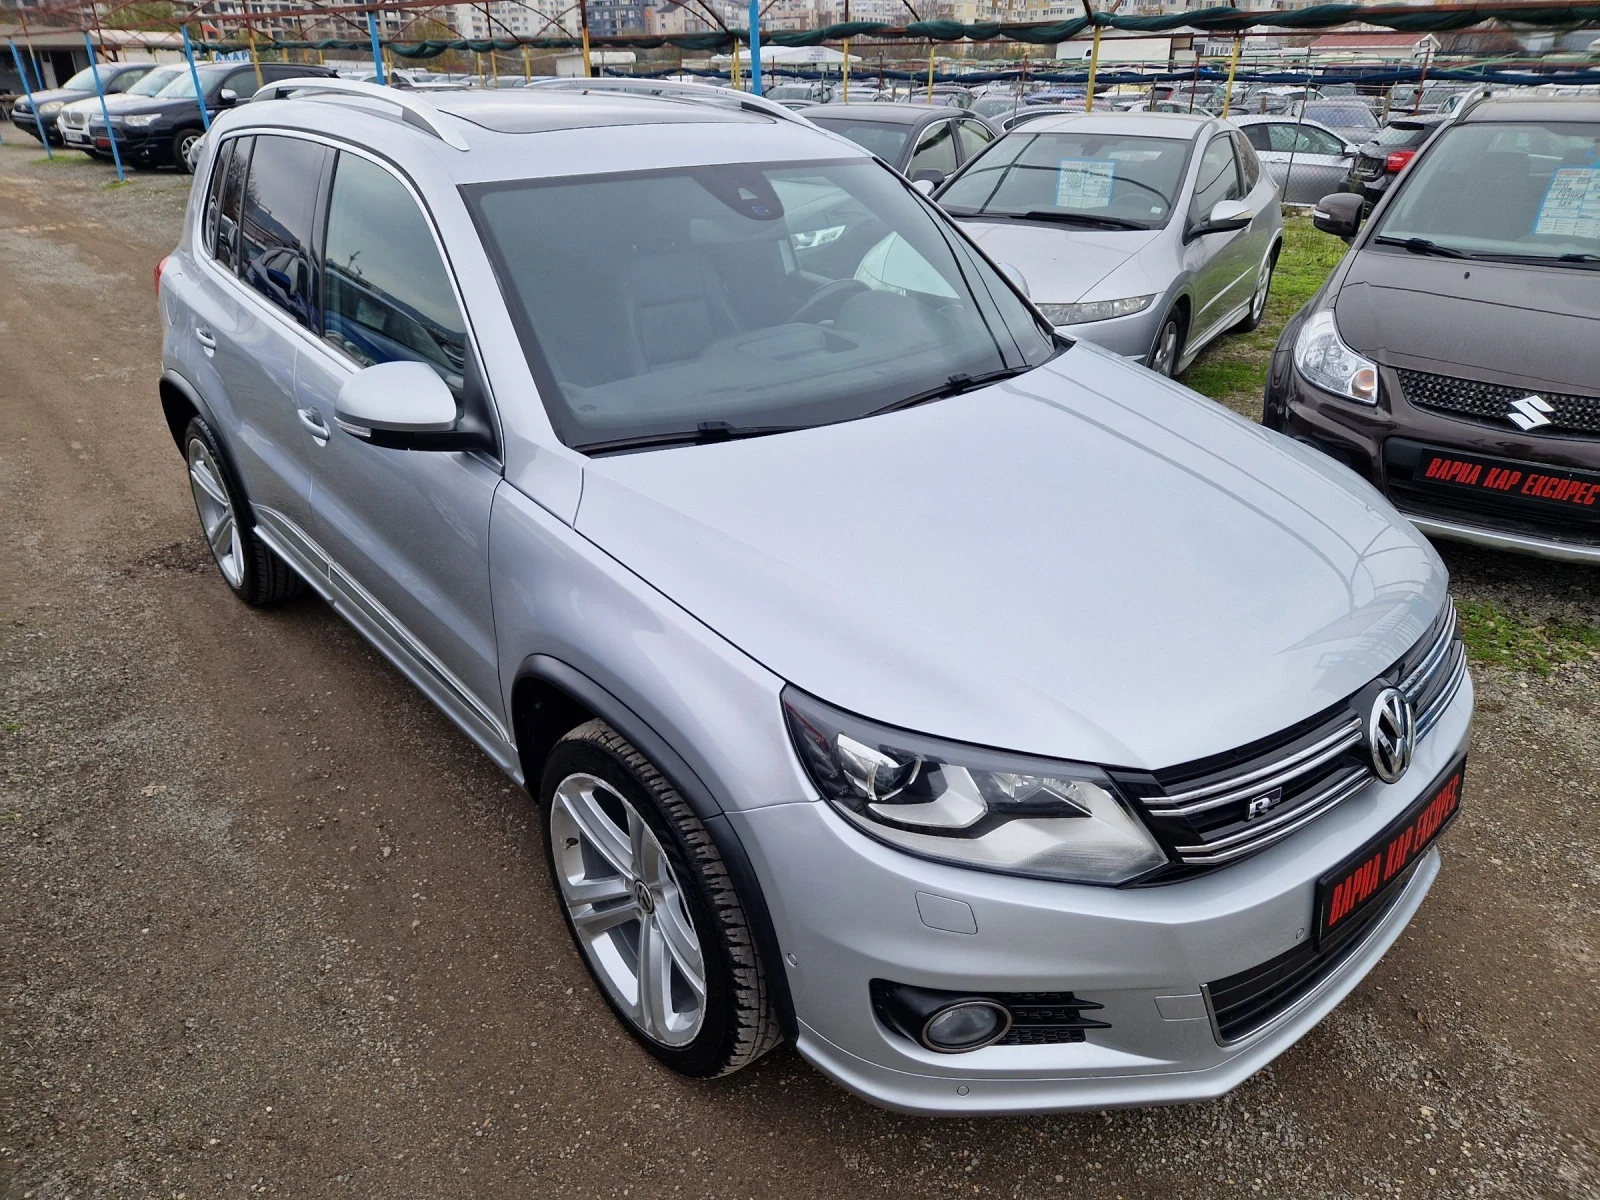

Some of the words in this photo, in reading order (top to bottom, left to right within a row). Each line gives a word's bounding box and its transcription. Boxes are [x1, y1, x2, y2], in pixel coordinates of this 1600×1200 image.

[1425, 457, 1482, 485] ВАРНА
[1483, 467, 1522, 491] КАР
[1521, 473, 1600, 506] ЕКСПРЕС
[1328, 852, 1381, 927] ВАРНА
[1383, 825, 1413, 881] КАР
[1413, 773, 1459, 853] ЕКСПРЕС
